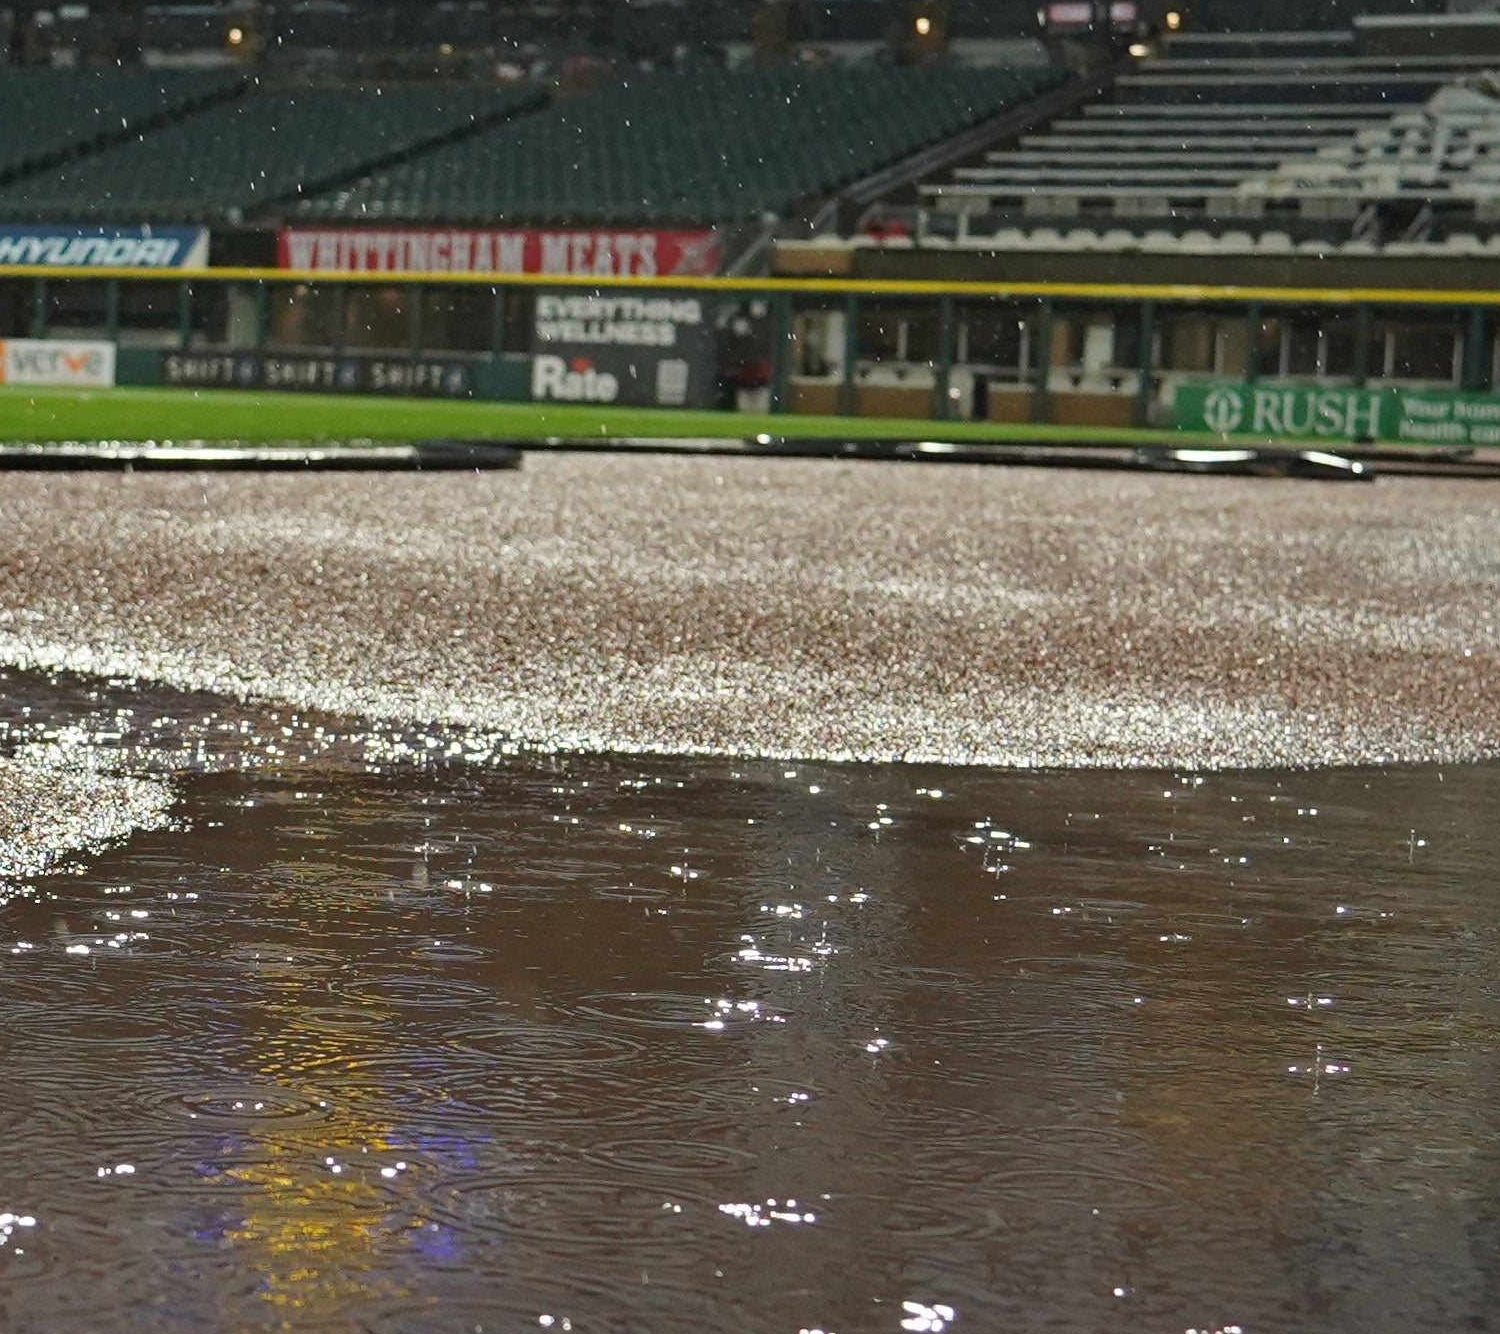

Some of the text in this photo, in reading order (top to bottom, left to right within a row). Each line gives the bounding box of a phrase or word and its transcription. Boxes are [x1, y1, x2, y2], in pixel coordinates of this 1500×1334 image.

[286, 230, 658, 278] WHITTINGHAM MEATS
[536, 295, 702, 325] EVERYTHING
[535, 320, 677, 347] WELLNESS
[371, 361, 443, 390] SHIFT
[531, 354, 620, 403] Rate
[1253, 388, 1380, 438] RUSH
[1402, 398, 1450, 418] Your
[1398, 420, 1468, 441] health
